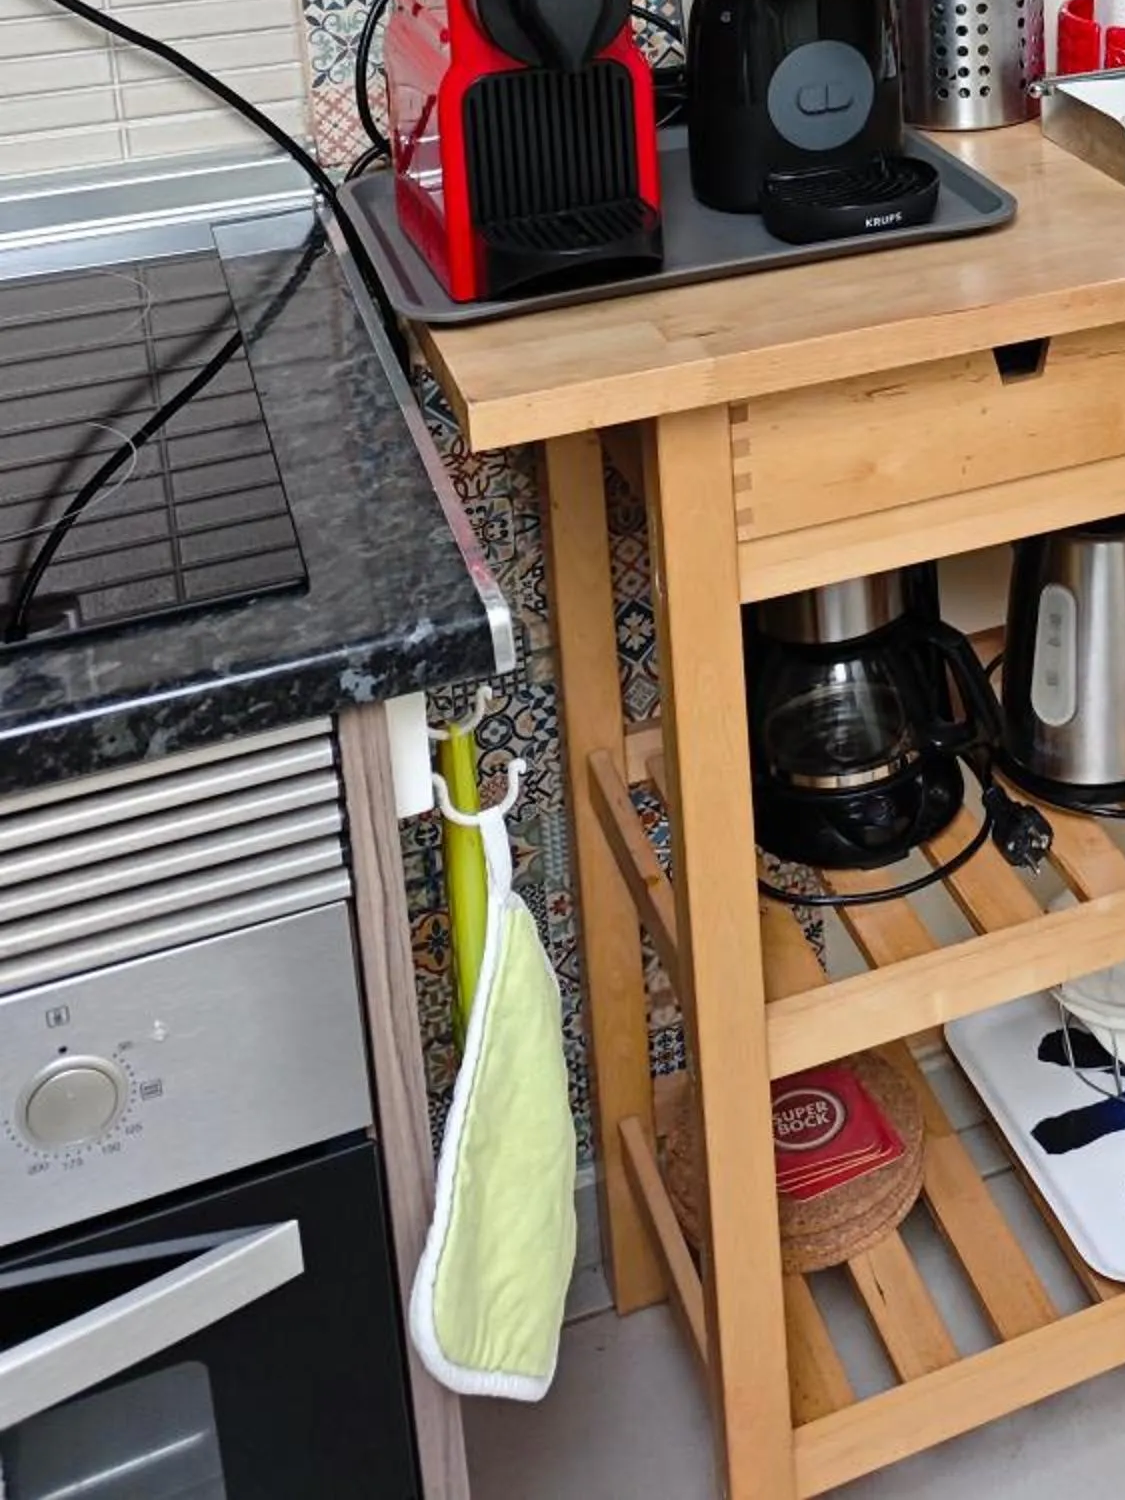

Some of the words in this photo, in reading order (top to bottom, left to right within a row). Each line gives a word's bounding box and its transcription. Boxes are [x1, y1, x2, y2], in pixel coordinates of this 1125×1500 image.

[865, 211, 903, 228] KRUPS
[774, 1100, 829, 1124] SUPER
[777, 1112, 831, 1136] BOCK
